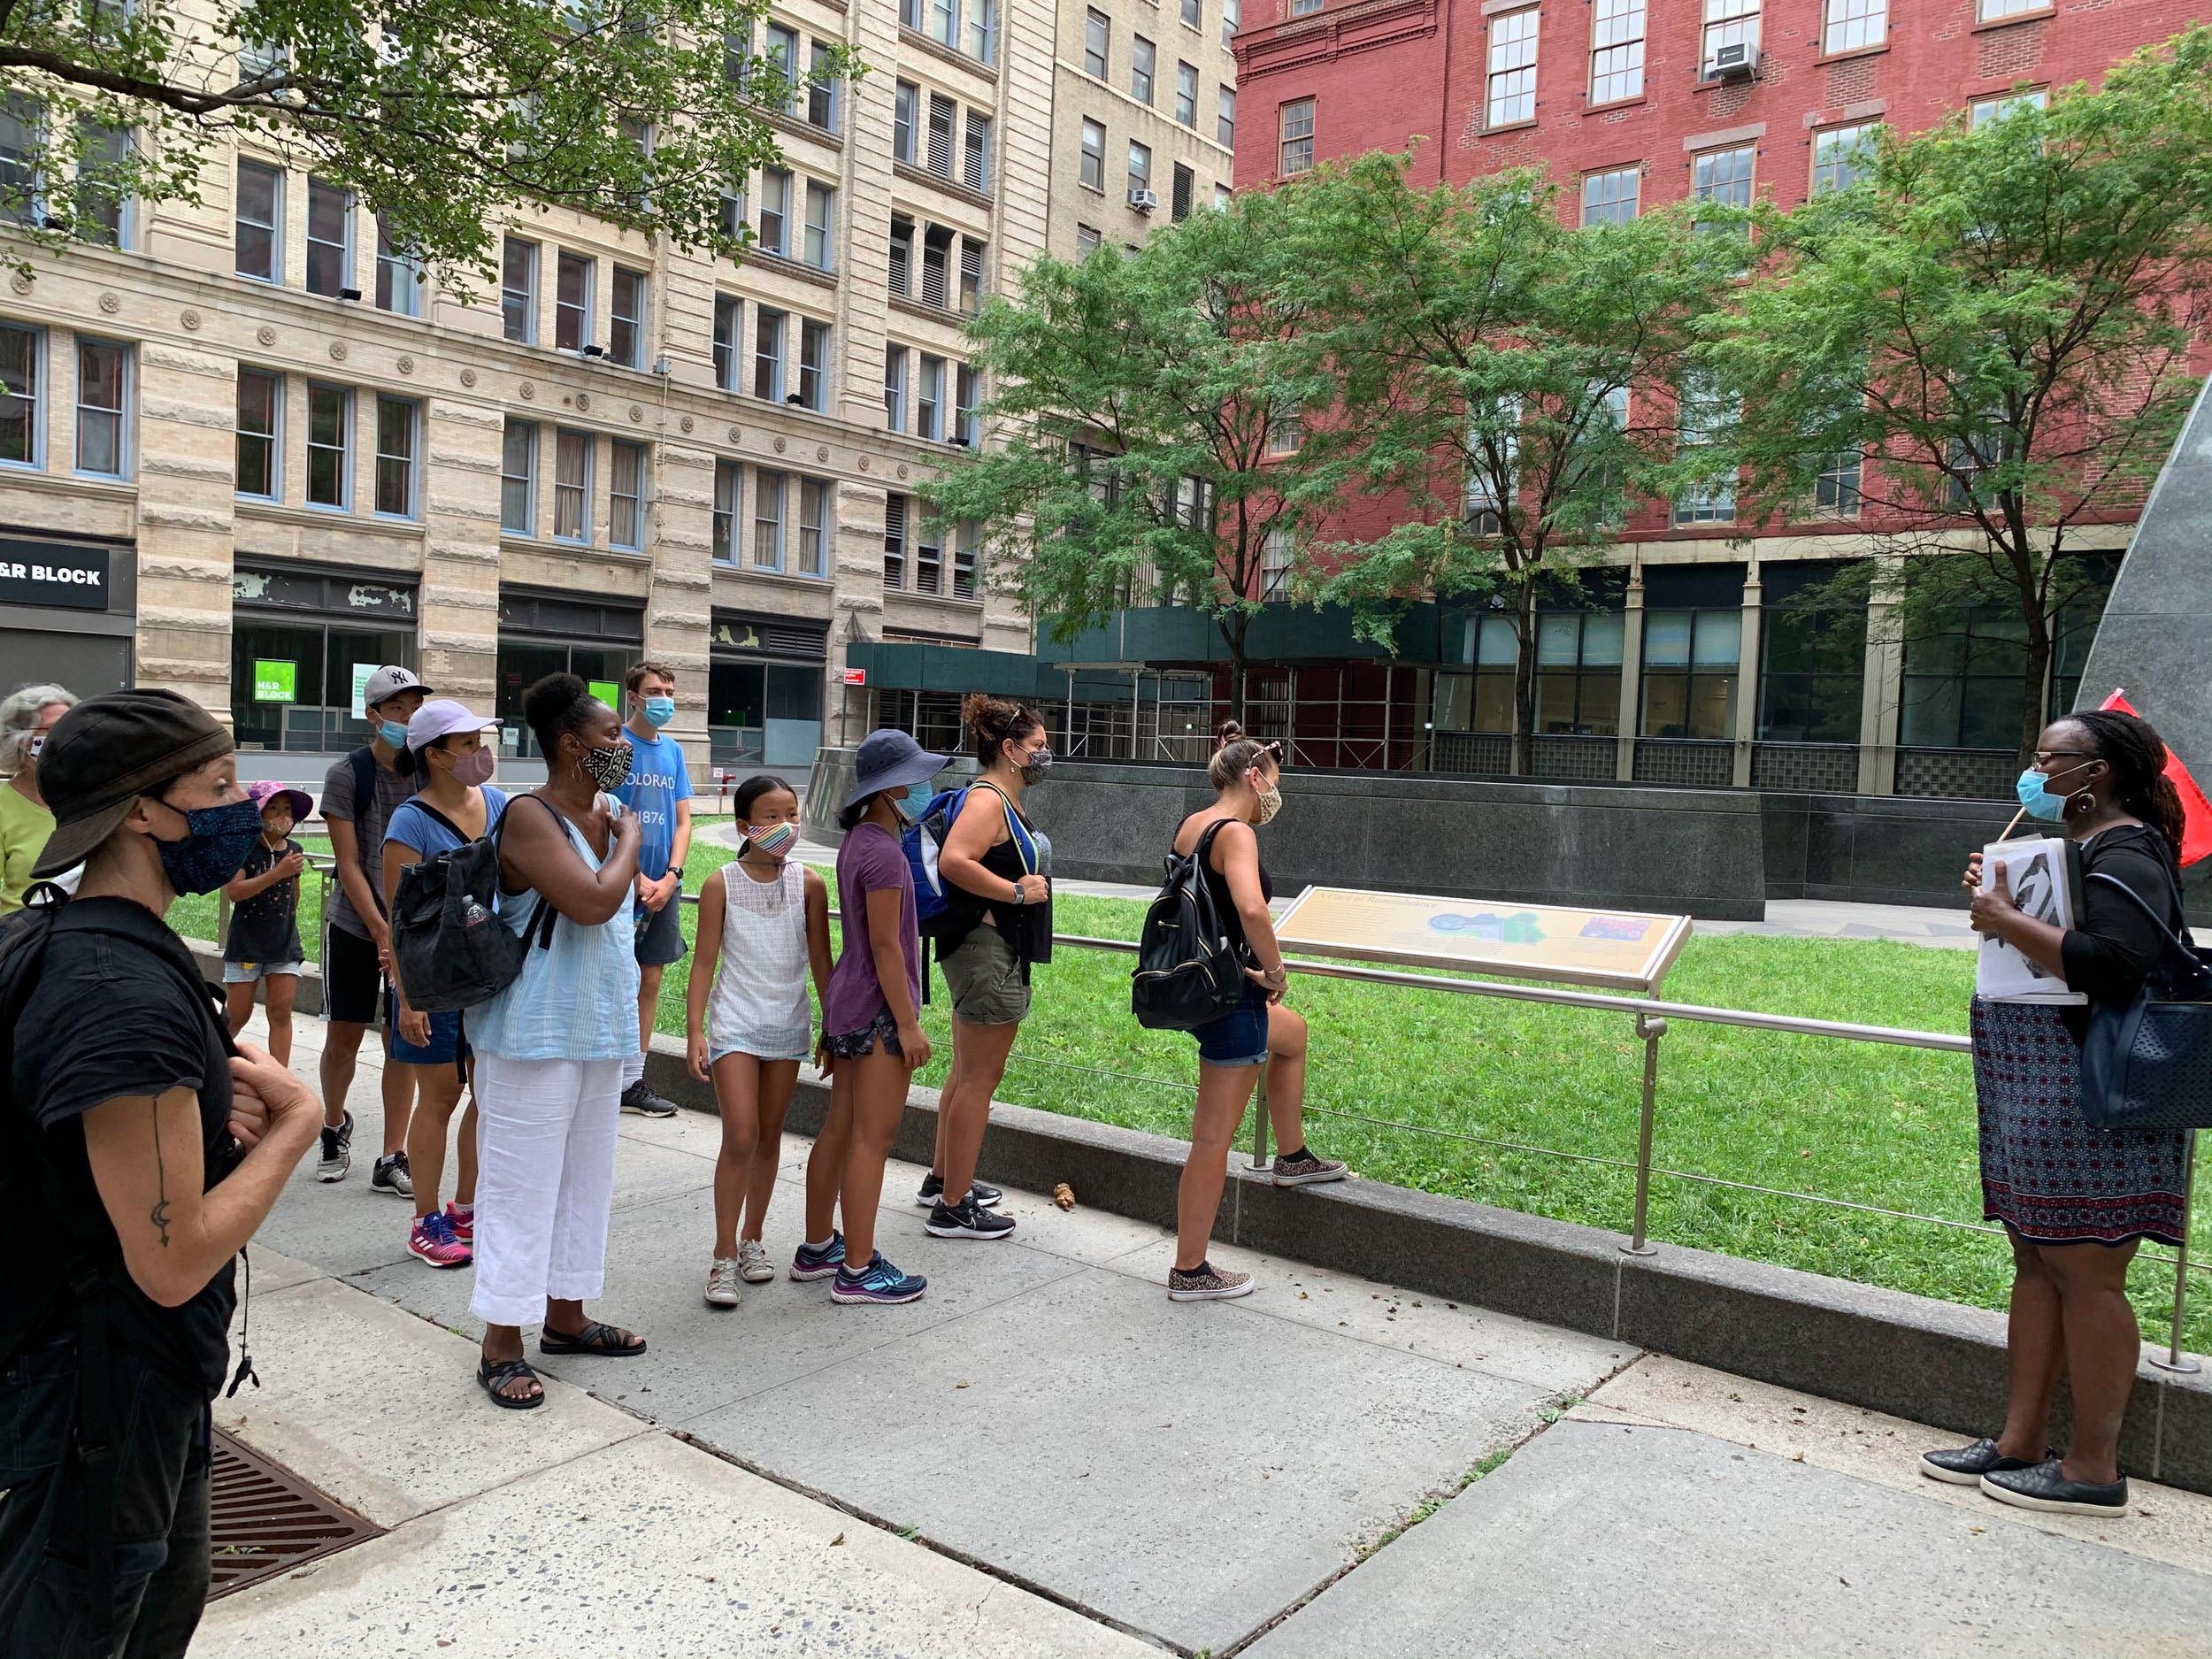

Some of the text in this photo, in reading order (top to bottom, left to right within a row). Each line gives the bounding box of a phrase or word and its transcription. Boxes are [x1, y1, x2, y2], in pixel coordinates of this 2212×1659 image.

[31, 565, 100, 585] BLOCK
[257, 681, 280, 690] H&R
[257, 690, 292, 700] BLOCK
[621, 772, 675, 789] OLORAD
[638, 810, 665, 826] 1876
[1366, 896, 1439, 908] Remembrance
